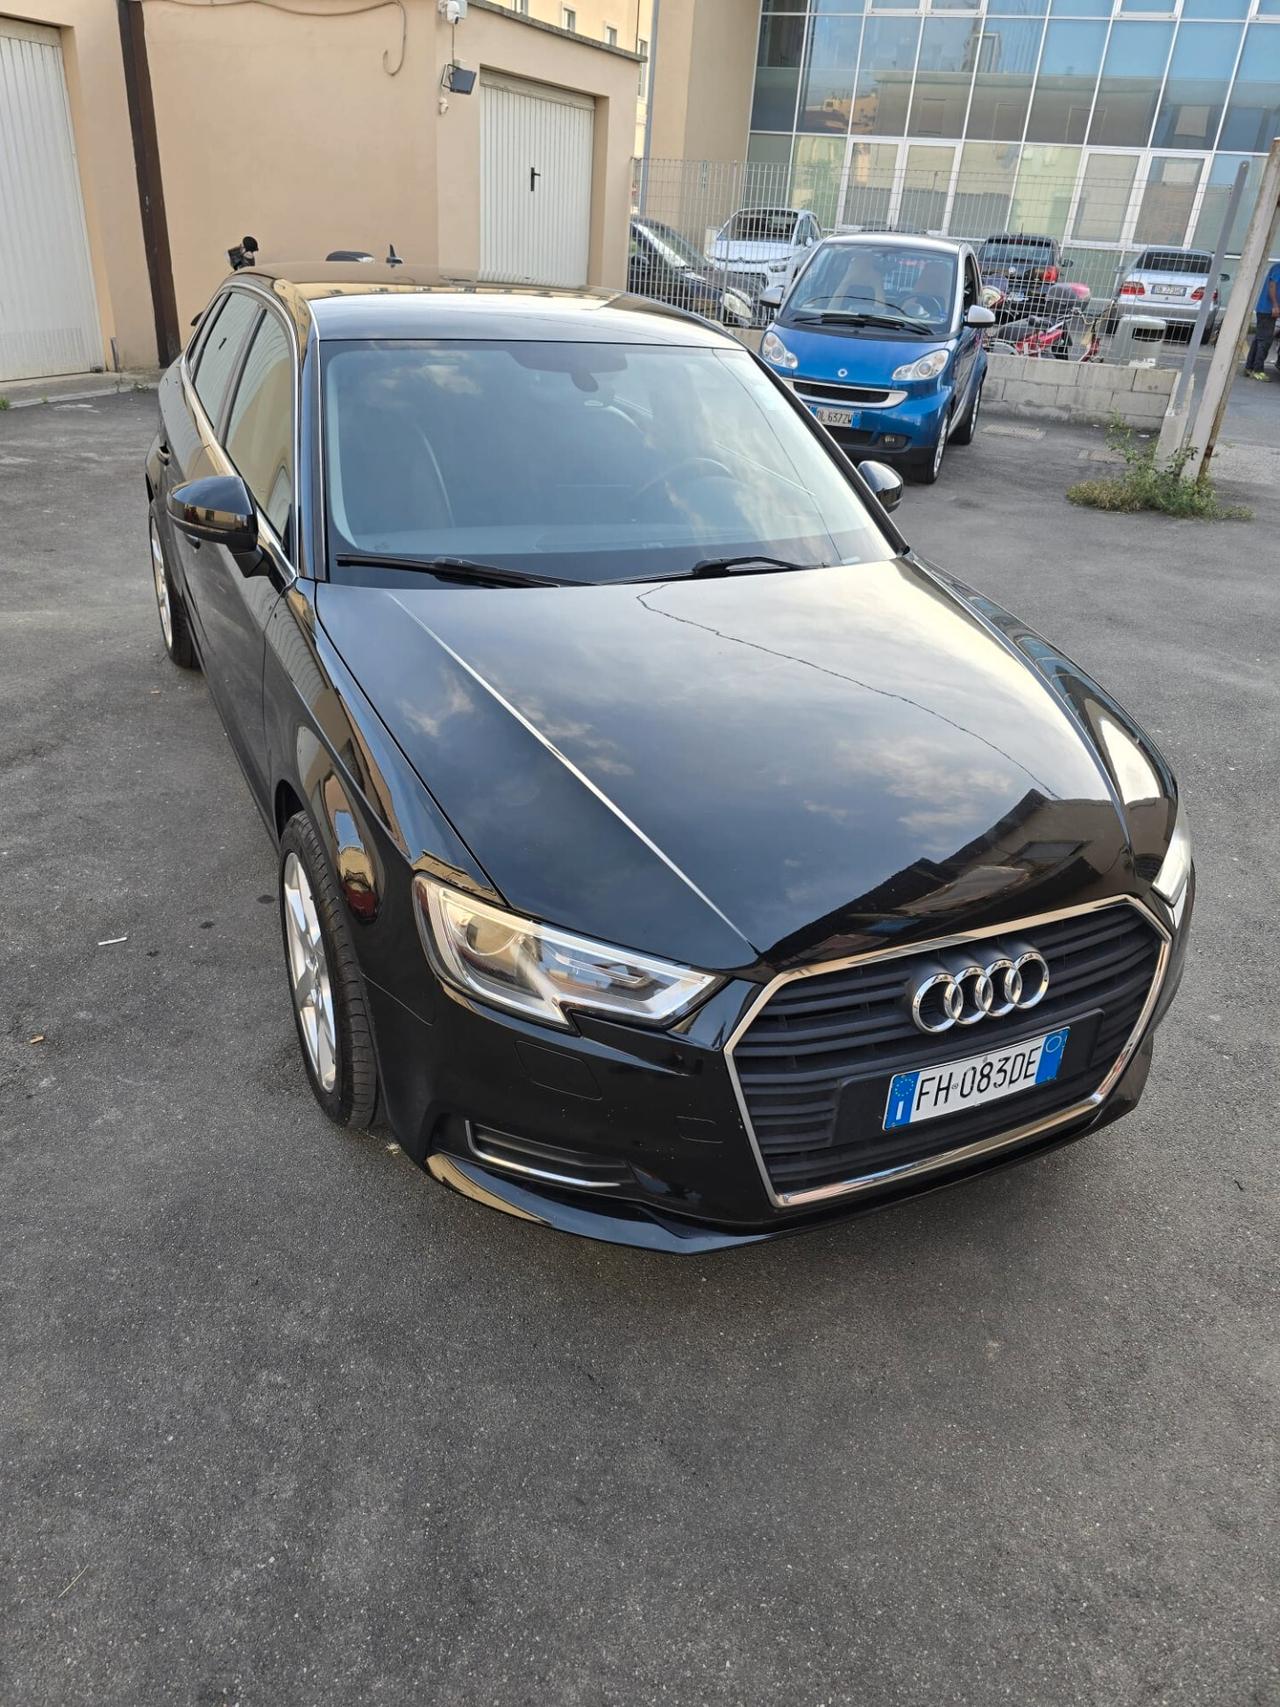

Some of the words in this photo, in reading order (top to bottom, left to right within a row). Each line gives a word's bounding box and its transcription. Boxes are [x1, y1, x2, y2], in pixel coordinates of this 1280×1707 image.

[915, 1072, 954, 1111] FH
[959, 1045, 1042, 1099] 083DE
[895, 1100, 905, 1121] I
